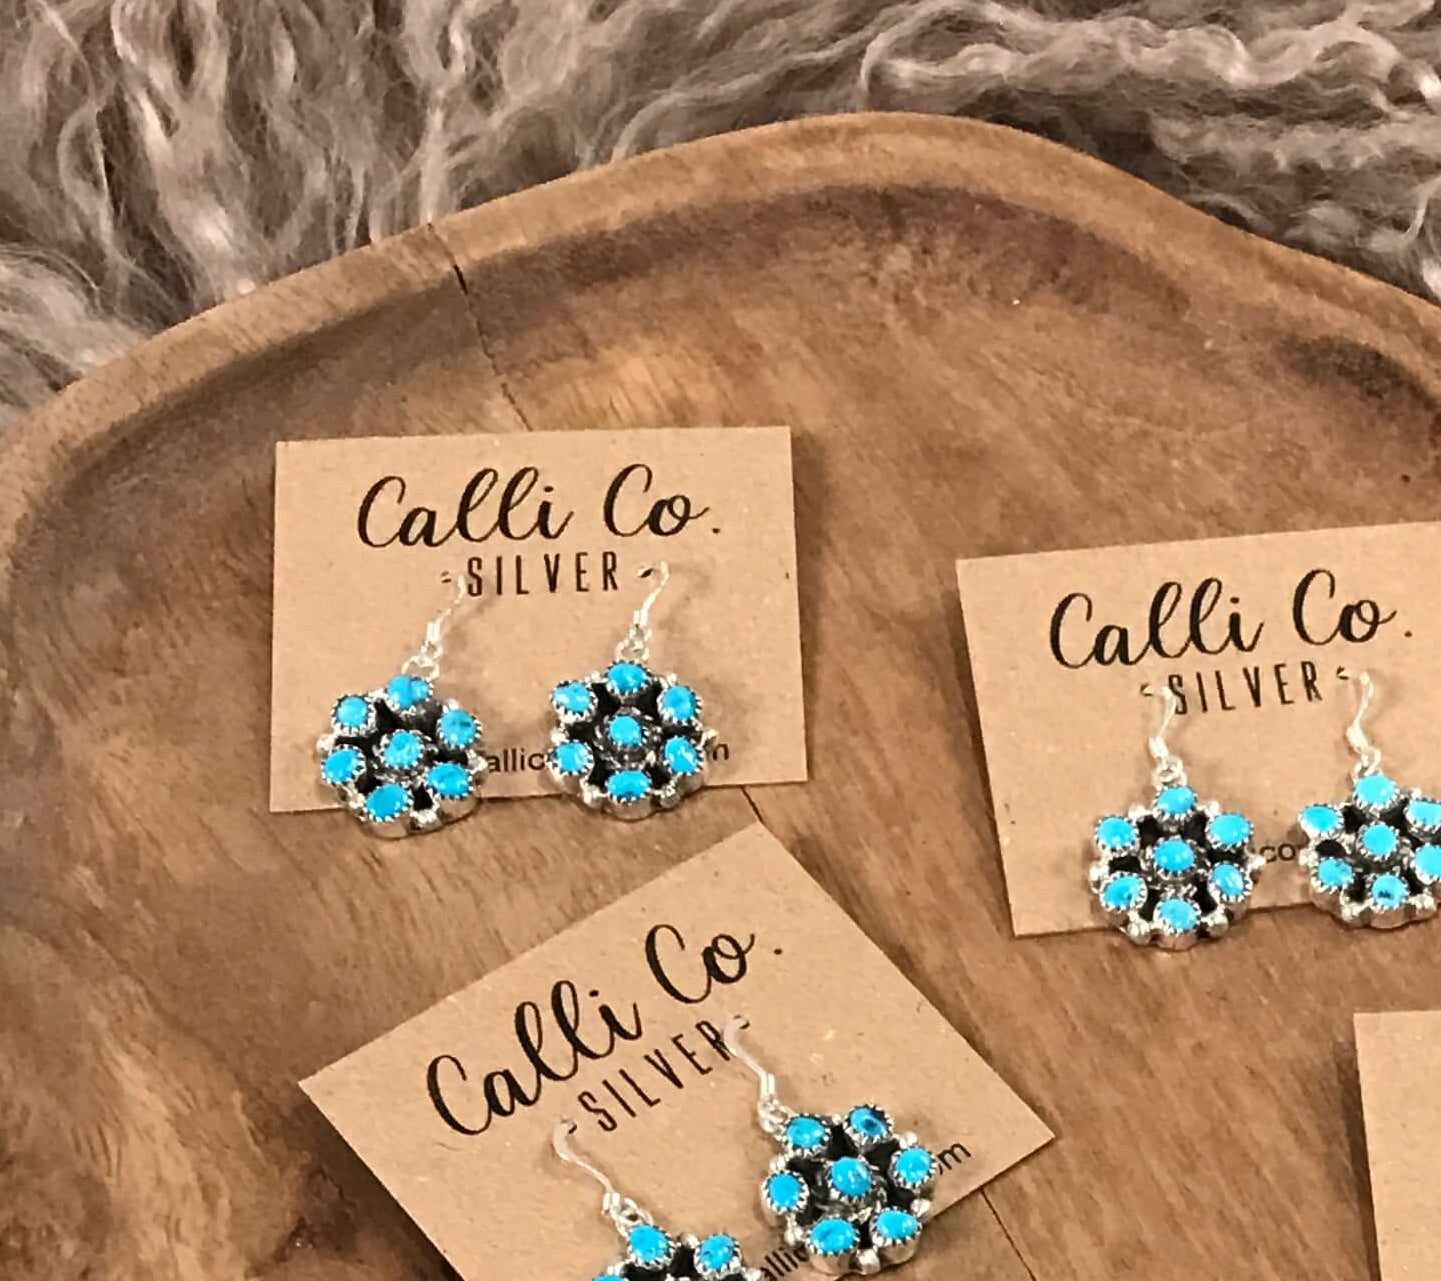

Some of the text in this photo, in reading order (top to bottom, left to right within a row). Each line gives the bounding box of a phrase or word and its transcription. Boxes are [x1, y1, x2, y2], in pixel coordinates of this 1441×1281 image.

[357, 463, 720, 548] Calli Co.
[467, 551, 619, 596] SILVER
[1050, 569, 1412, 669] Calli Co.
[1168, 661, 1323, 715] SILVER
[426, 924, 783, 1136] Calli Co.
[578, 1016, 734, 1132] SILVER
